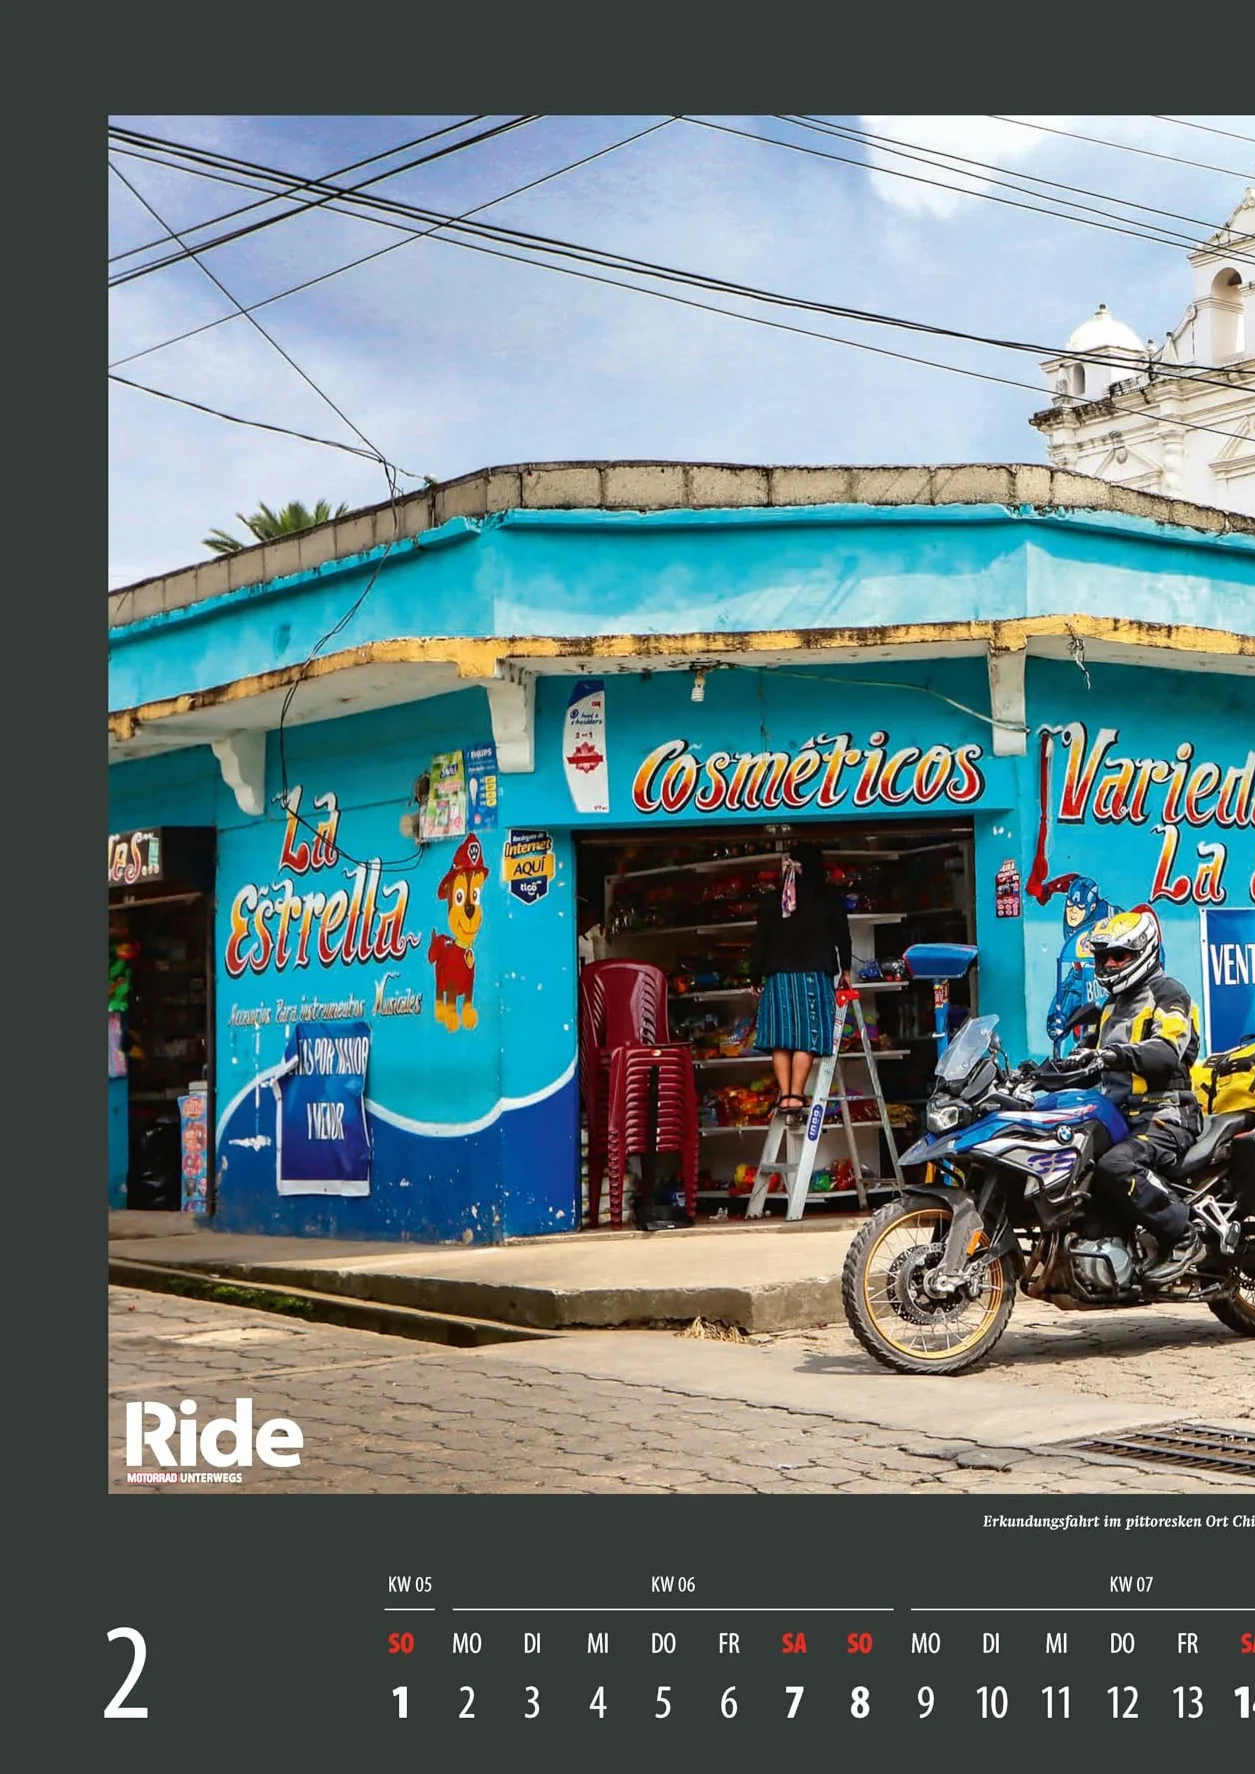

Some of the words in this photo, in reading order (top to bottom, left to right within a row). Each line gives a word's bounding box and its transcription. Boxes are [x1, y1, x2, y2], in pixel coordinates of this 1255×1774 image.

[632, 730, 987, 815] Cosméticos
[272, 785, 341, 874] La
[504, 839, 552, 858] Internet
[513, 856, 546, 877] AQUÍ
[1150, 823, 1227, 904] La
[225, 858, 422, 981] Estrella
